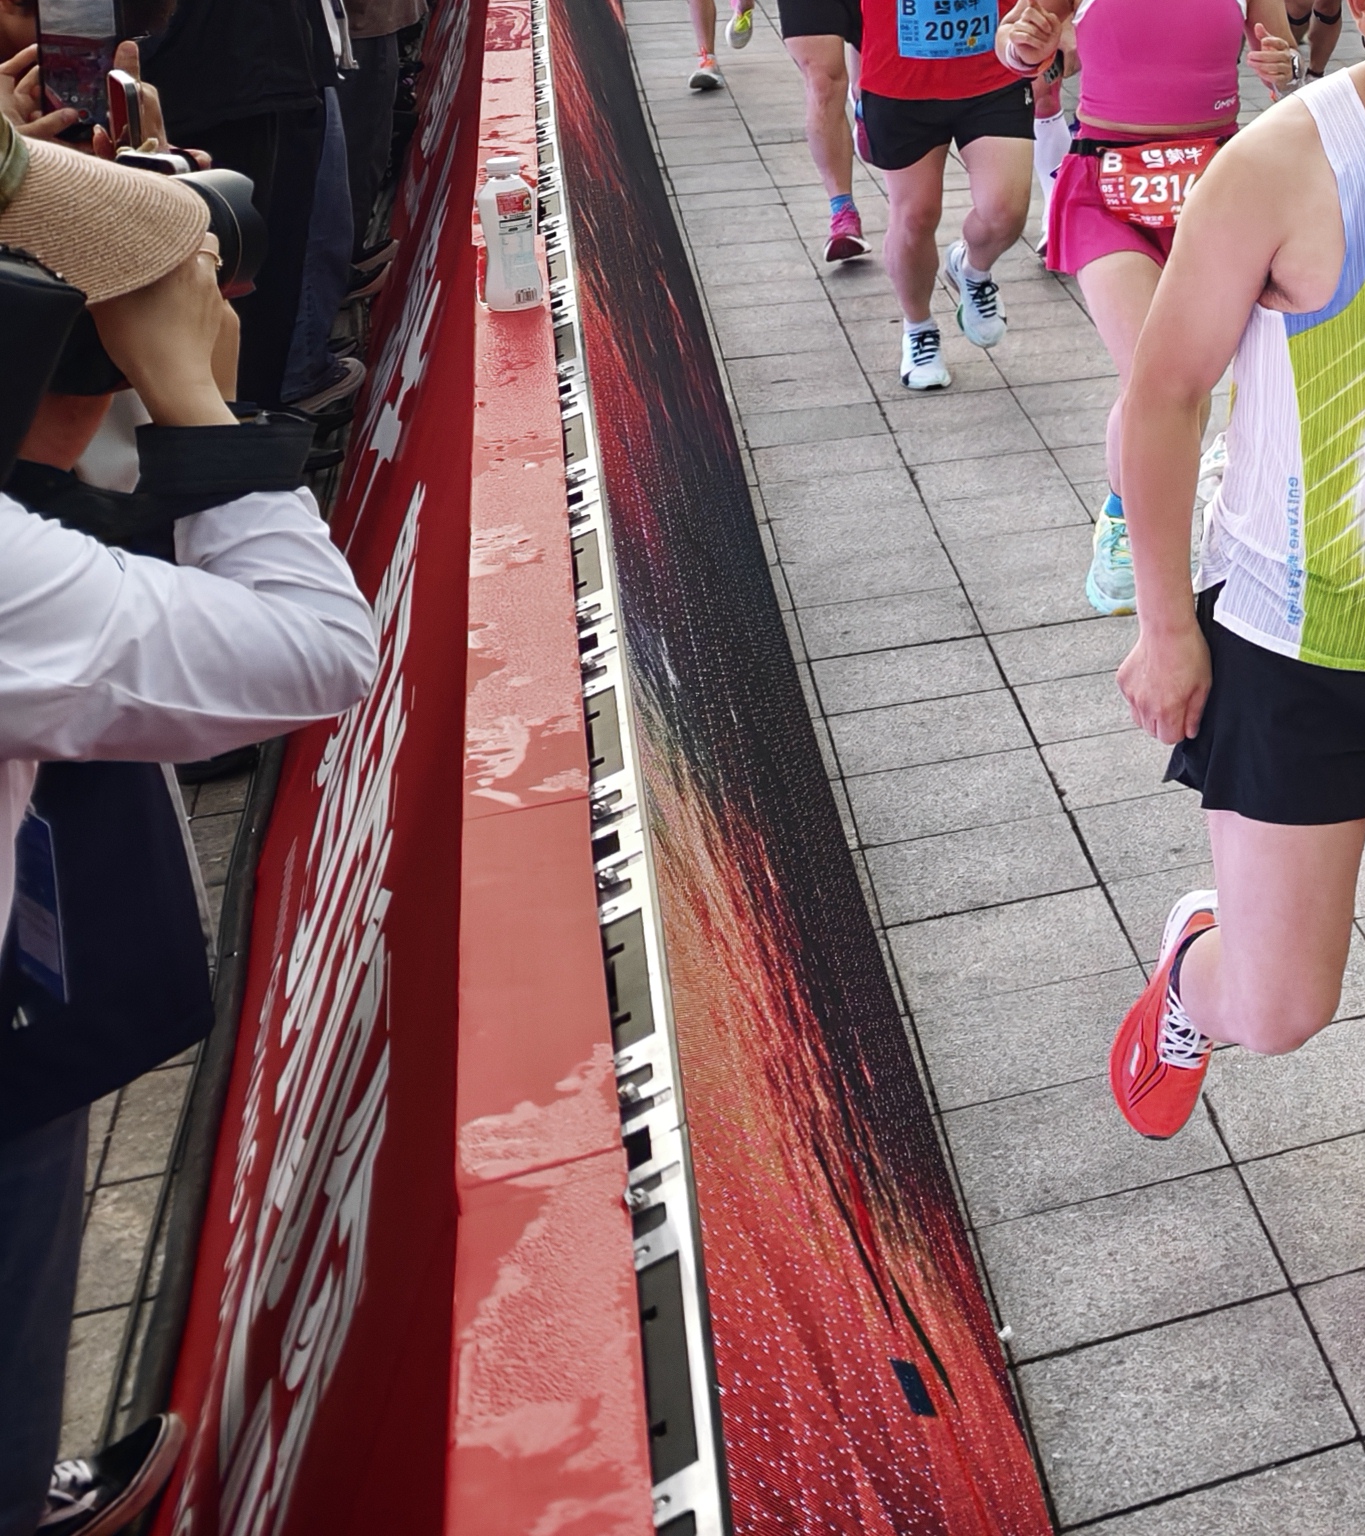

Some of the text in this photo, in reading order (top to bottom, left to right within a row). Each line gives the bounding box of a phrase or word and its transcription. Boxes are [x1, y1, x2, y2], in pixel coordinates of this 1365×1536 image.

[924, 14, 989, 41] 20921
[1103, 152, 1122, 173] B
[1165, 146, 1203, 165] 蒙牛
[1287, 476, 1300, 552] GUIYANG
